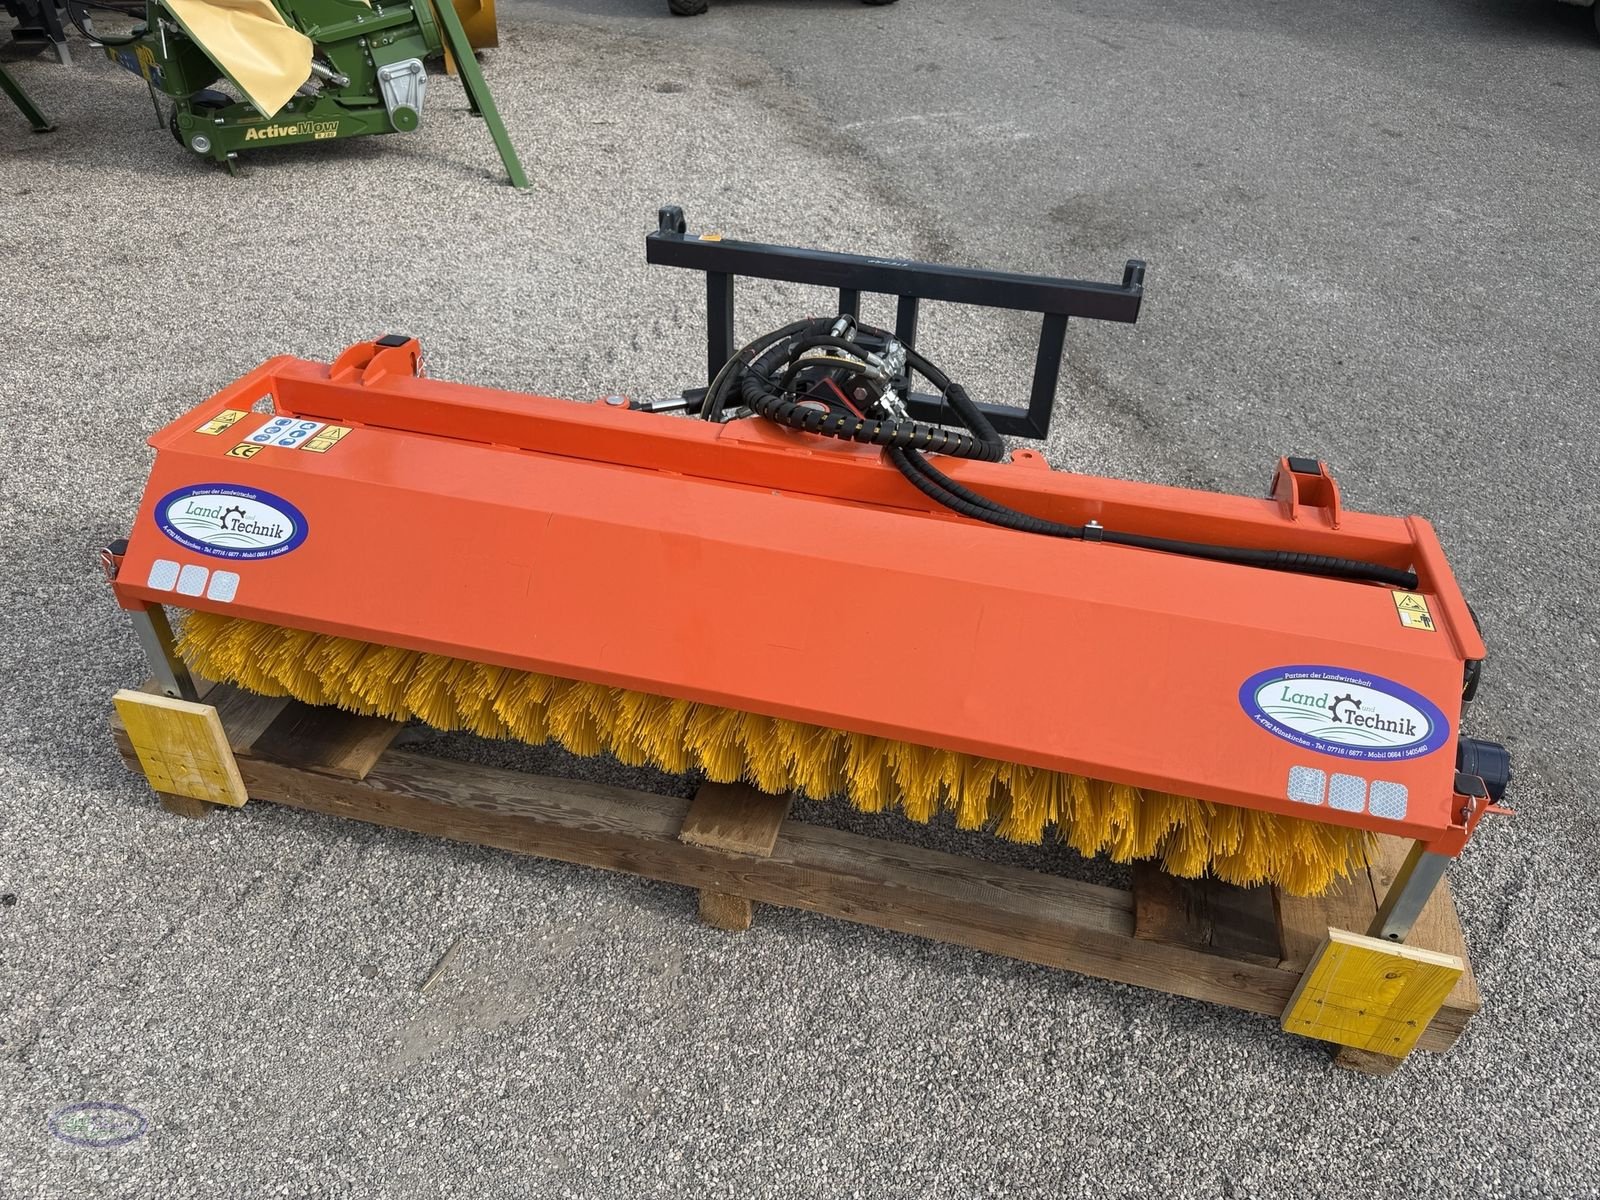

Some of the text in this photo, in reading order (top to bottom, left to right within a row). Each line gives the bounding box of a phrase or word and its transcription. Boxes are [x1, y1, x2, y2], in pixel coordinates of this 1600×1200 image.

[245, 121, 339, 140] ActiveMow
[231, 445, 261, 457] CE
[220, 489, 257, 499] Landwirtschaft
[185, 501, 222, 519] Land
[231, 518, 284, 539] Technik
[1322, 673, 1372, 687] Landwirtschaft
[1280, 686, 1329, 709] Land
[1344, 709, 1417, 736] Technik
[1315, 742, 1326, 751] Tel.
